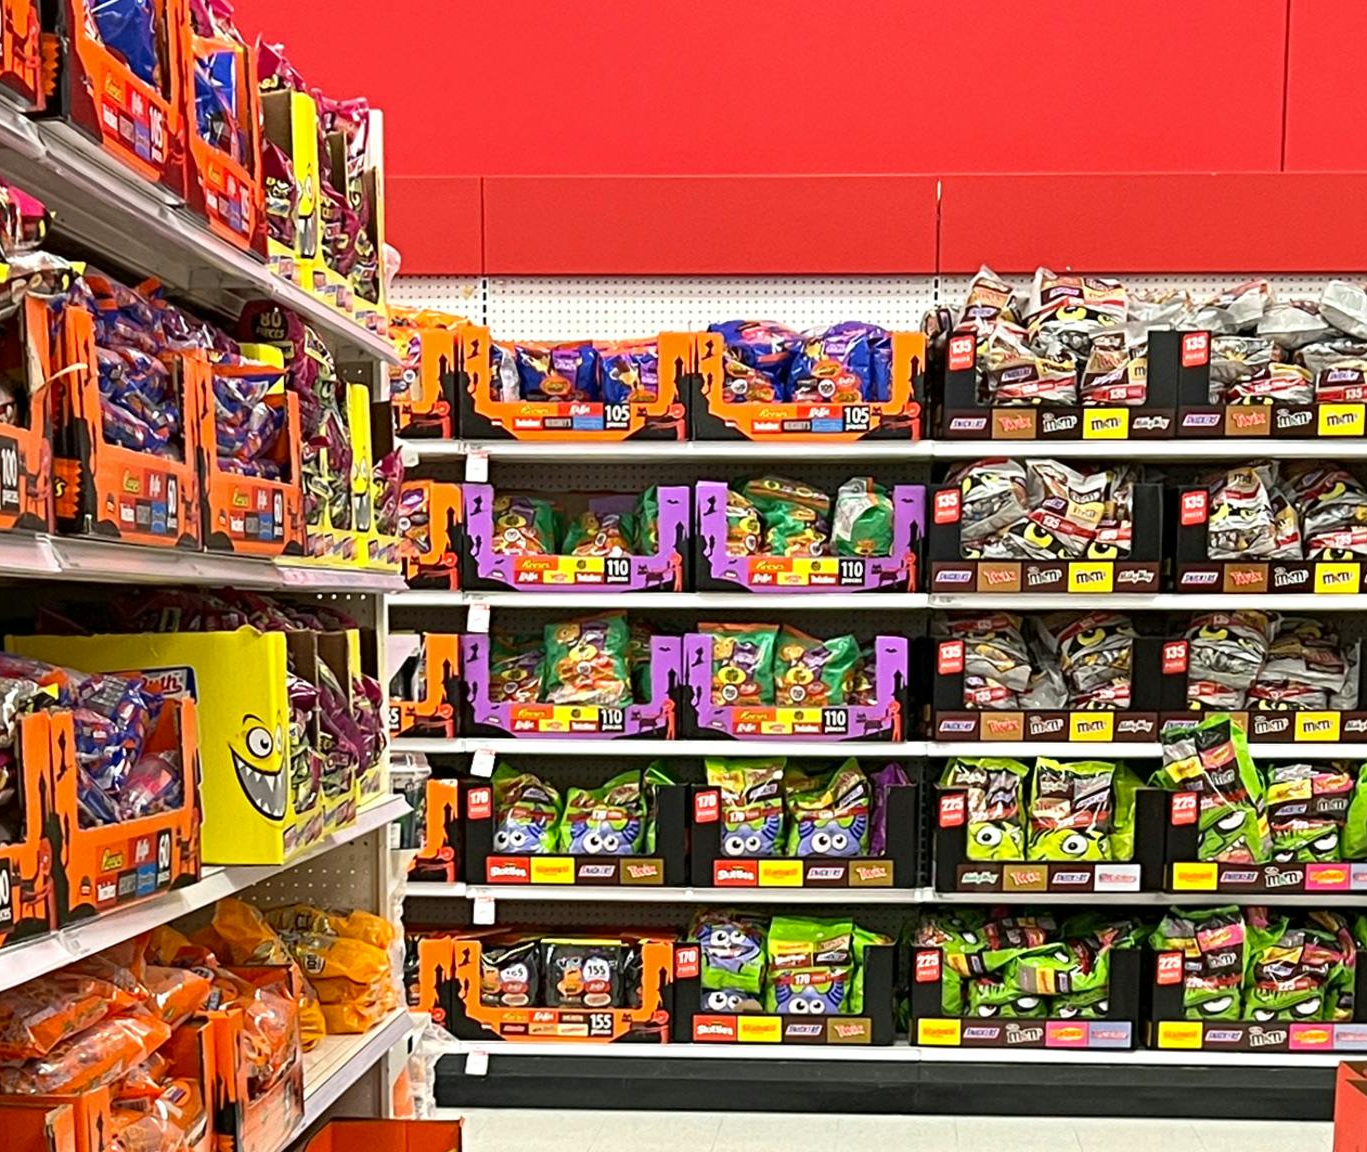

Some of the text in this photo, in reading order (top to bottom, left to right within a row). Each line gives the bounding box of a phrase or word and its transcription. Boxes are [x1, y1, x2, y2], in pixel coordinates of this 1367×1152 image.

[951, 342, 971, 353] 135
[1185, 338, 1206, 350] 135
[605, 404, 629, 422] 105
[844, 406, 869, 424] 105
[937, 494, 957, 507] 135
[1184, 495, 1205, 507] 135
[606, 559, 628, 576] 110
[841, 561, 864, 577] 110
[941, 648, 962, 659] 135
[1165, 646, 1186, 659] 135
[602, 708, 623, 725] 110
[824, 711, 846, 726] 110
[470, 791, 488, 805] 170
[697, 794, 717, 807] 170
[942, 797, 963, 812] 225
[1173, 796, 1195, 810] 225
[676, 950, 697, 964] 170
[917, 954, 938, 968] 225
[1159, 956, 1181, 968] 225
[589, 1013, 611, 1030] 155
